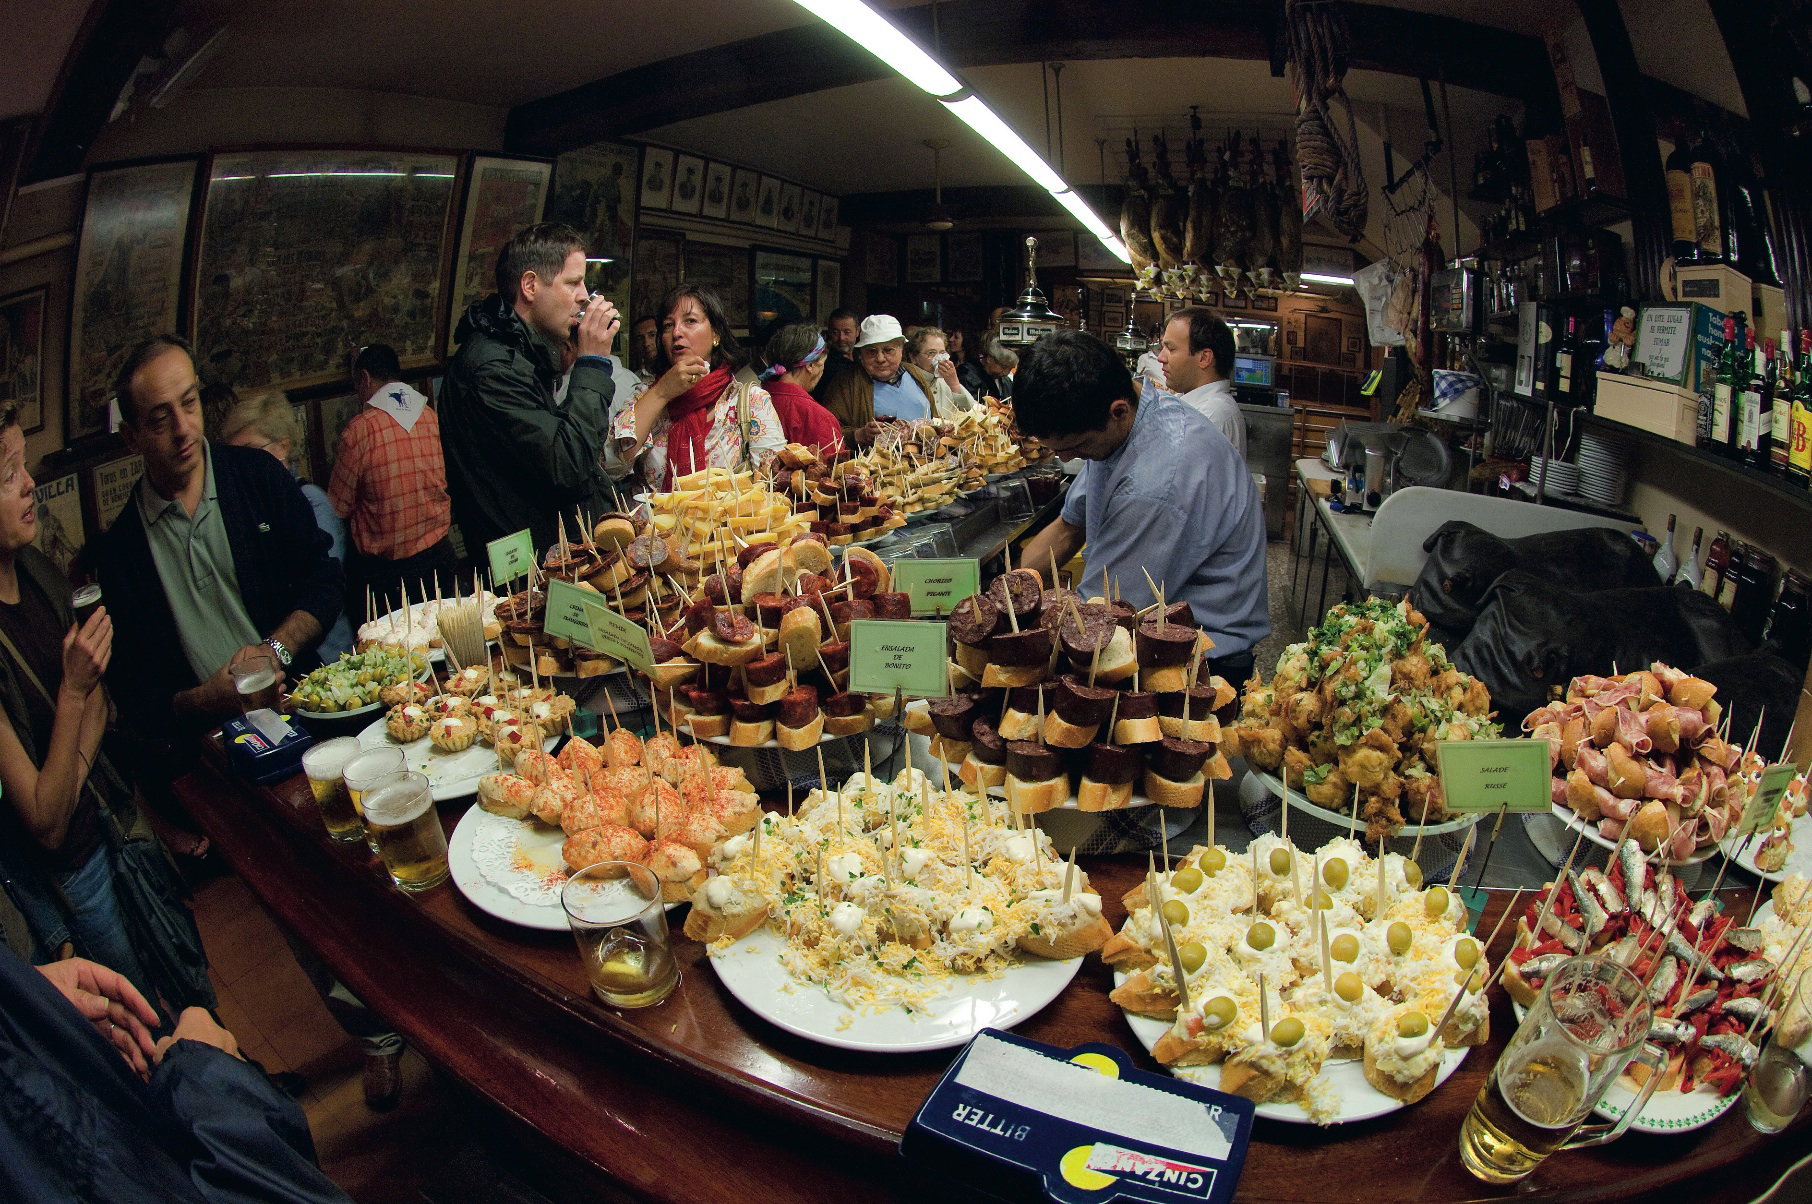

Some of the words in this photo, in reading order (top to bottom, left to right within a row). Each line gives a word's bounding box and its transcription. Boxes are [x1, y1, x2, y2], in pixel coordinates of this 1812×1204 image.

[100, 471, 117, 487] Toros
[119, 467, 129, 479] en
[130, 459, 144, 476] ZAR
[34, 476, 74, 502] VILLA
[880, 645, 915, 653] ENSALADA
[884, 662, 912, 670] BONITO
[951, 1102, 1032, 1142] BITTER
